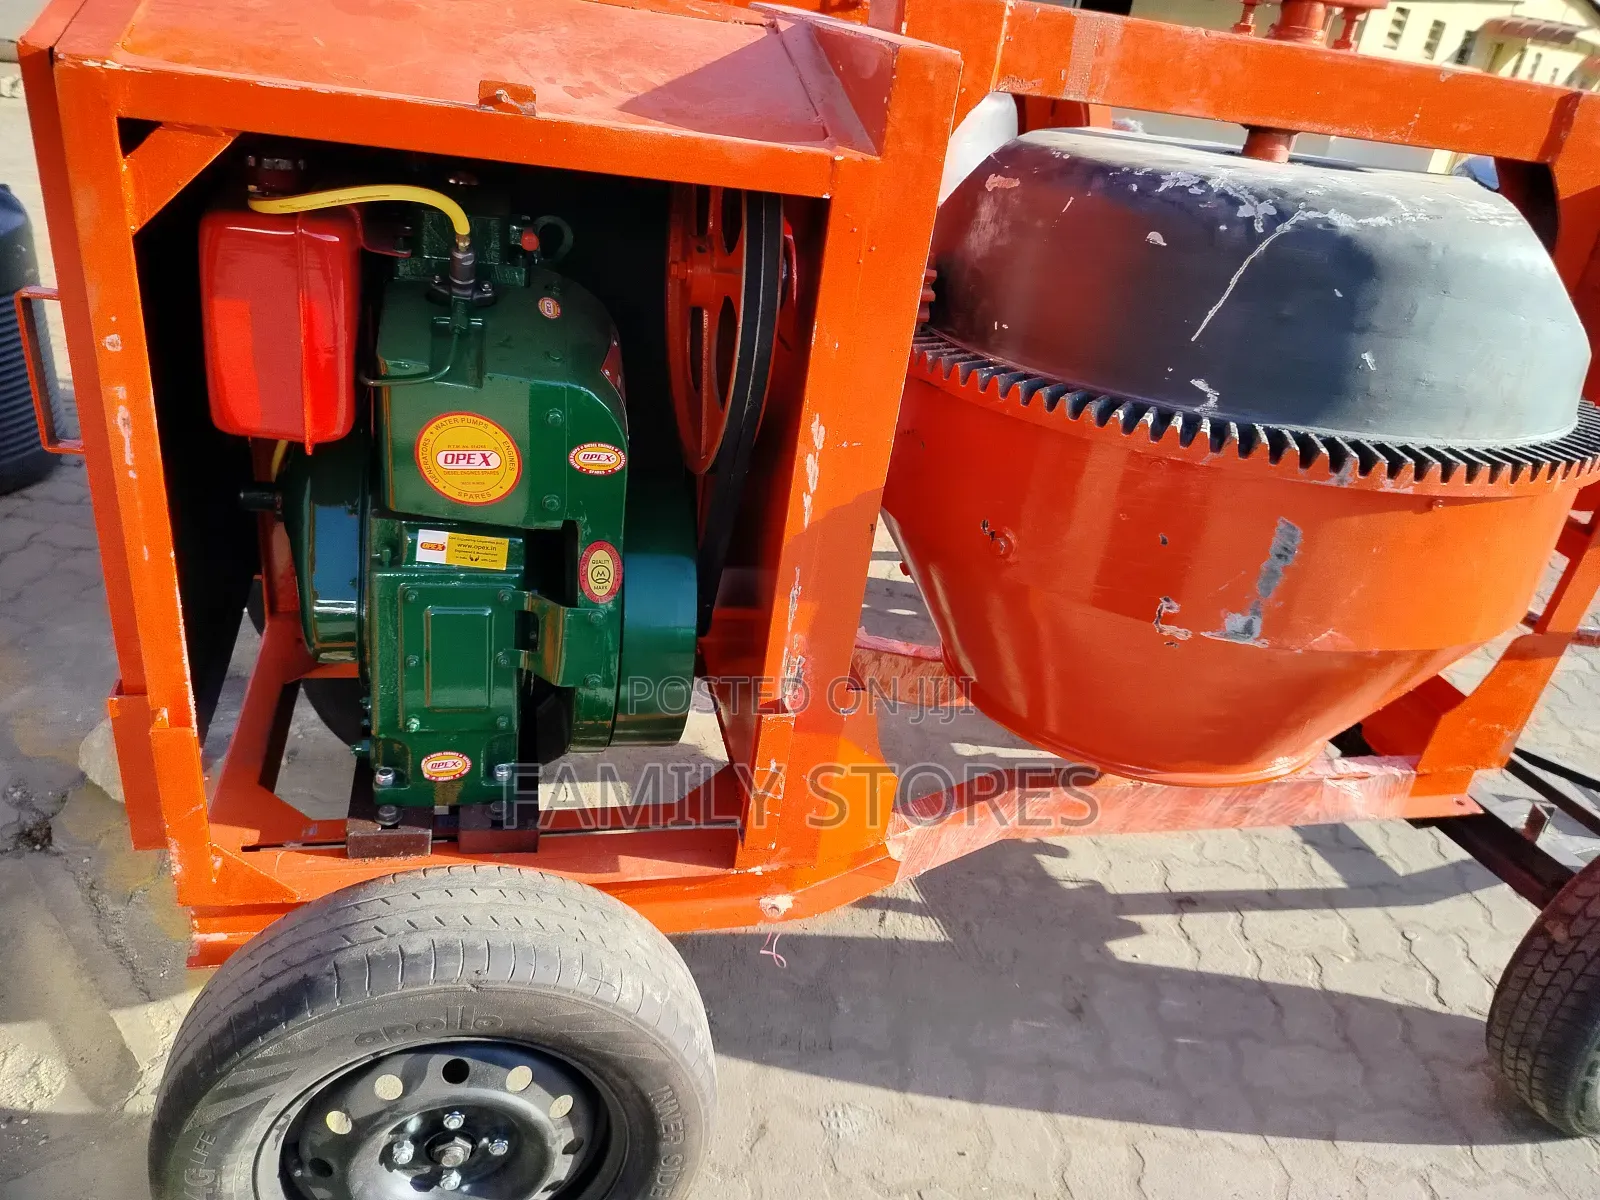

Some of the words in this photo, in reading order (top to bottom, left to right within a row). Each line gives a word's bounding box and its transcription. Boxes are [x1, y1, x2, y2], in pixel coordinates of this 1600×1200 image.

[434, 417, 460, 431] WATER
[460, 417, 489, 430] PUMPS
[421, 437, 440, 484] GENERATORS
[444, 453, 494, 467] OPEX
[502, 440, 516, 472] ENGINES
[583, 453, 613, 462] OPEX
[457, 491, 492, 500] SPARES
[421, 543, 445, 551] OPEX
[457, 543, 497, 551] www.opex.in
[431, 760, 458, 769] OPEX
[648, 1084, 686, 1146] INNER
[649, 1152, 685, 1199] SIDE
